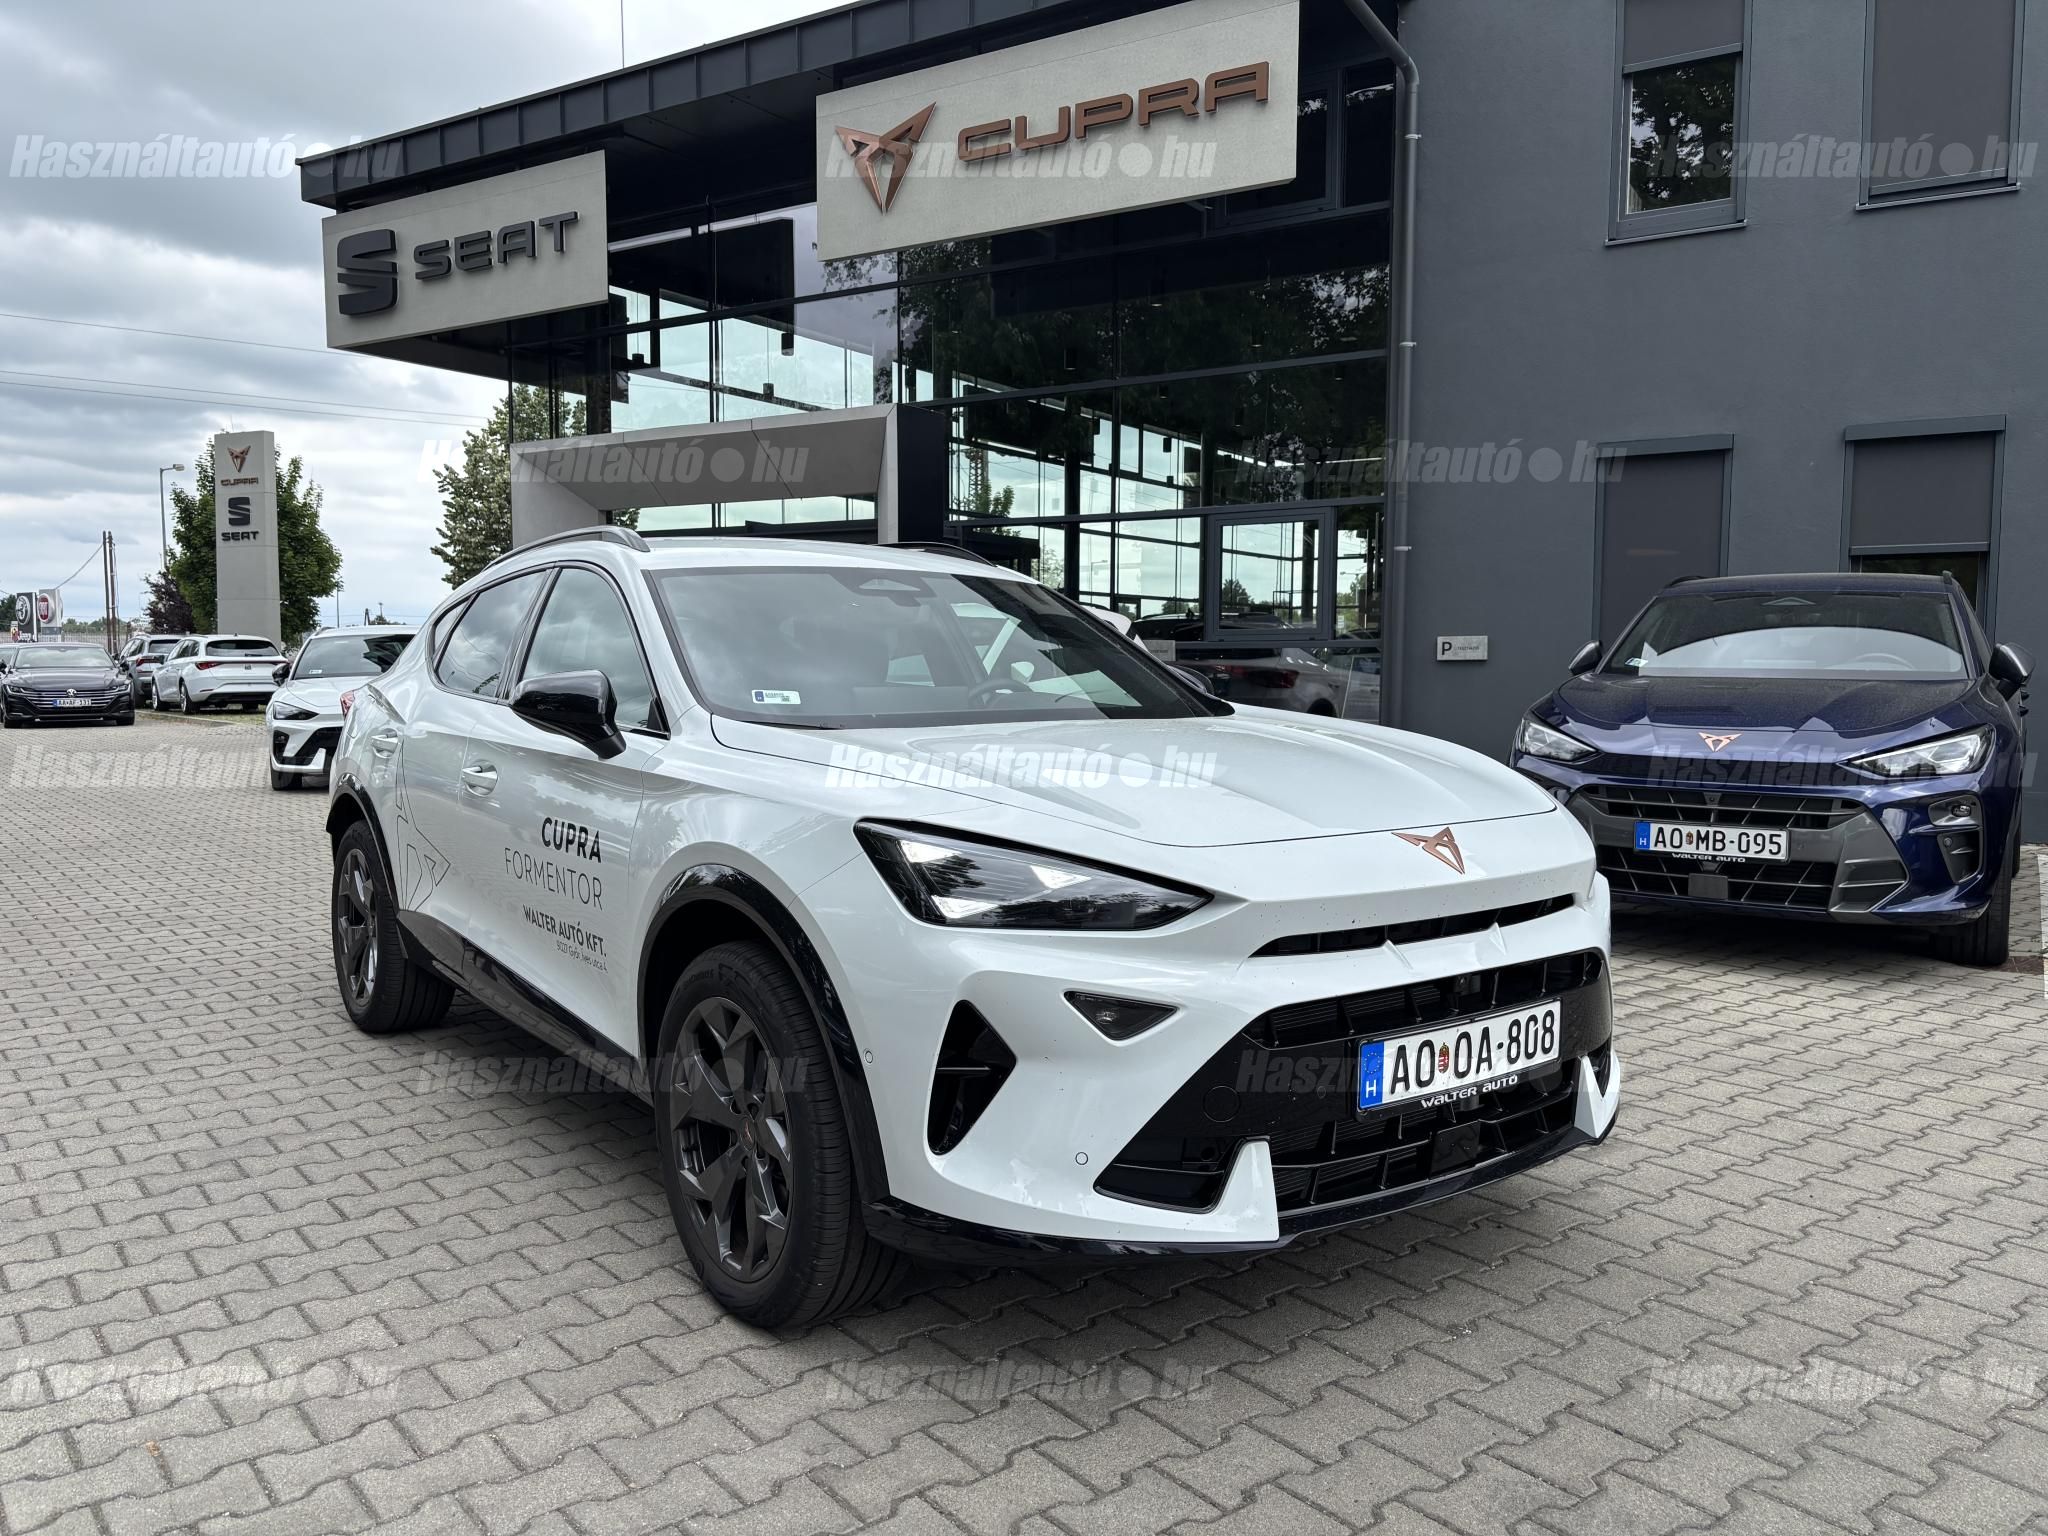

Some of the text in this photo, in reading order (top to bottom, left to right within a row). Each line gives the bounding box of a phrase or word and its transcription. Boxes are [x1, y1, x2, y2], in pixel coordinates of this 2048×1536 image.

[957, 61, 1270, 162] CUPRA
[414, 211, 579, 281] SEAT
[220, 477, 259, 487] CUPRA
[221, 530, 260, 542] SEAT
[1441, 641, 1453, 656] P
[541, 817, 602, 863] CUPRA
[504, 847, 603, 911] FORMENTOR
[523, 904, 557, 935] WALTER
[559, 921, 584, 947] AUTÓ
[586, 932, 607, 957] KFT.
[1365, 1079, 1377, 1098] H
